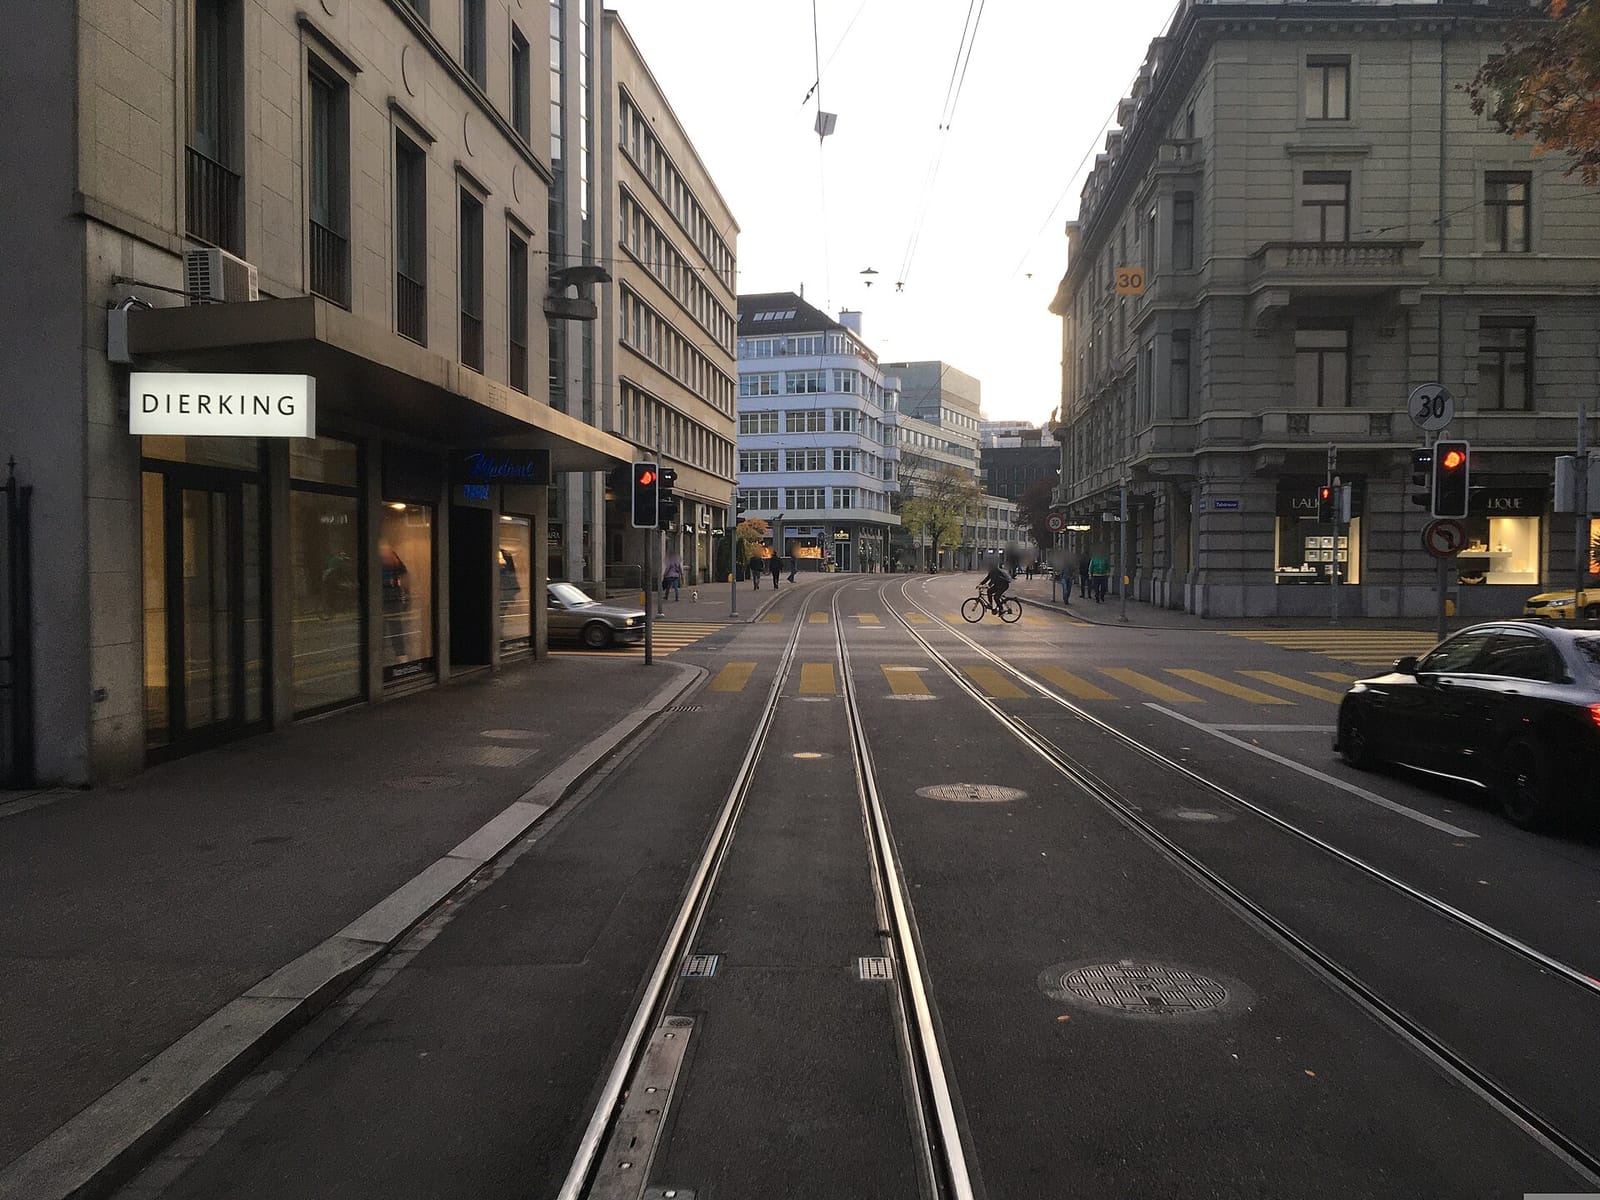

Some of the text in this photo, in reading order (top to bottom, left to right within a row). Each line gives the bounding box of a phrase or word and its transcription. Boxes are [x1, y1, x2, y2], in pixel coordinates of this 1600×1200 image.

[1118, 274, 1142, 288] 30
[142, 393, 295, 416] DIERKING
[1419, 395, 1445, 418] 30
[1292, 497, 1319, 509] LALI
[1488, 497, 1523, 510] LIQUE
